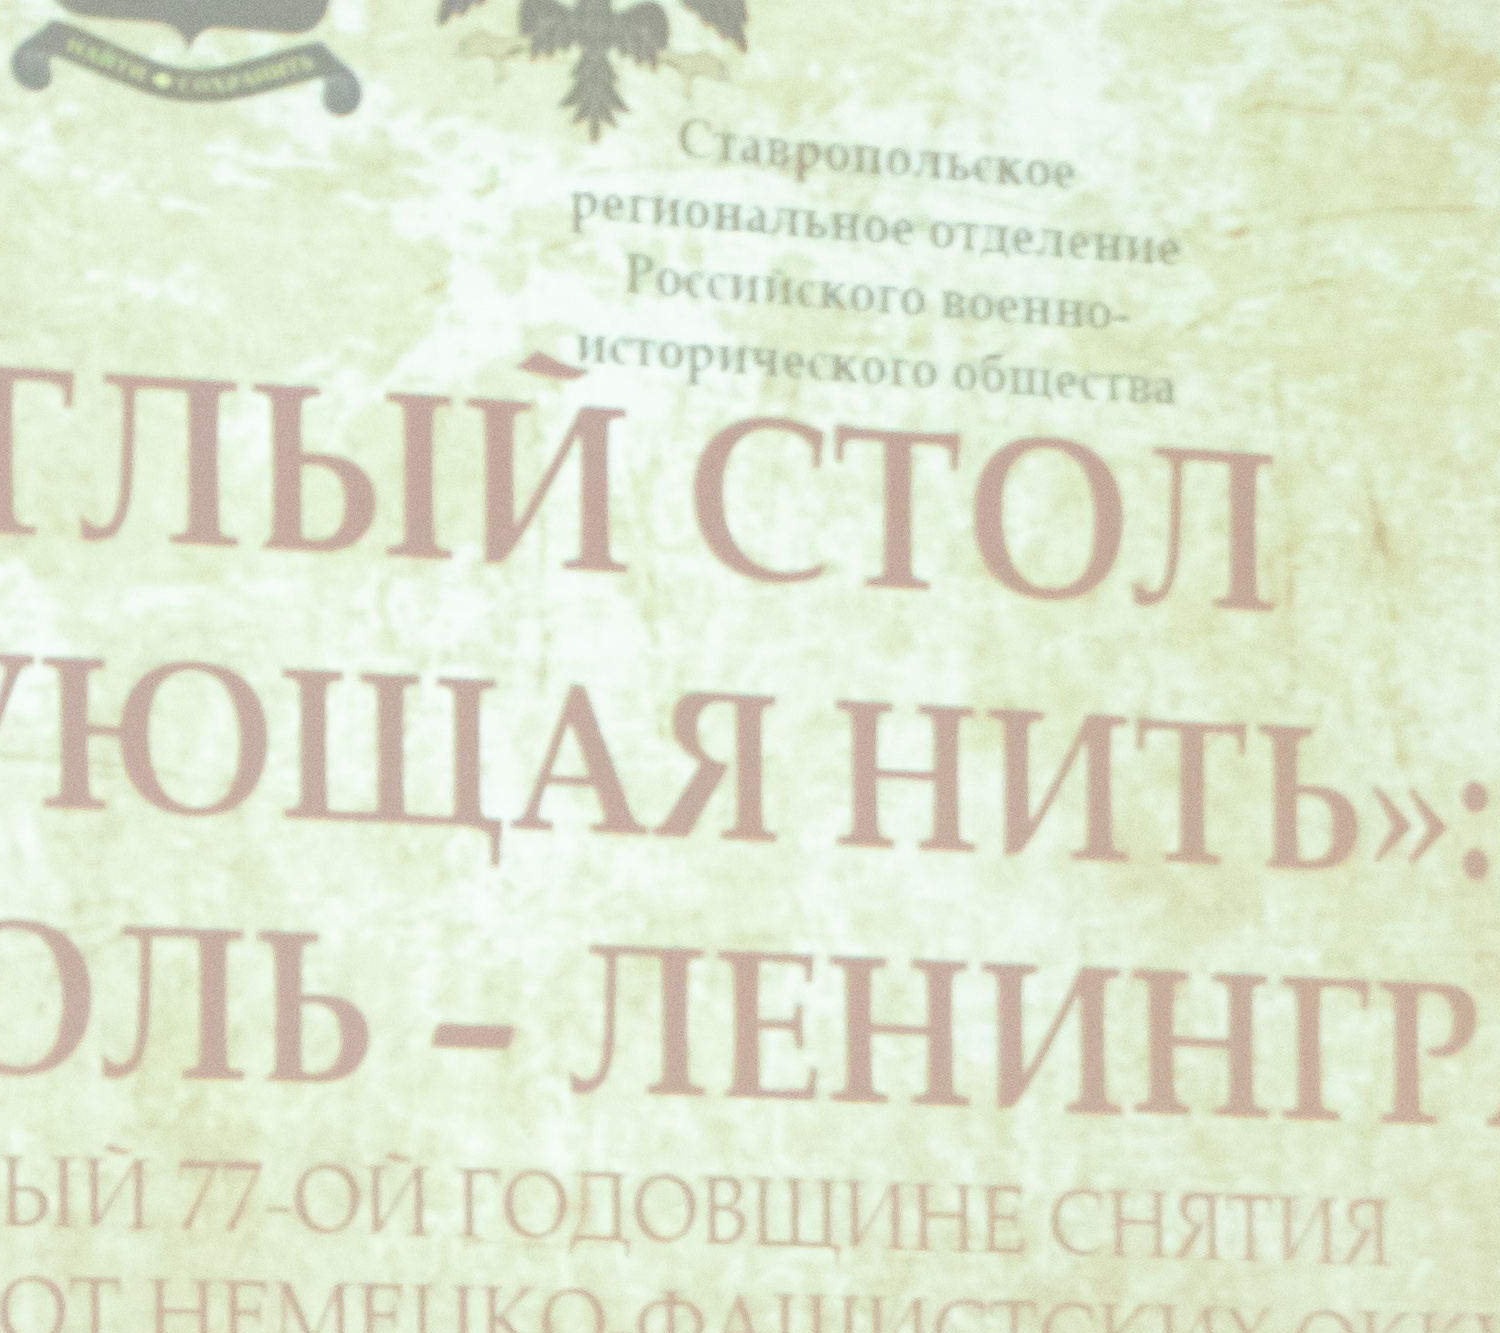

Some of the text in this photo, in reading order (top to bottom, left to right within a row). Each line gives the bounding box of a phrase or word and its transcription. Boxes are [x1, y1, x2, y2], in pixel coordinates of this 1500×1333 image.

[677, 117, 1077, 191] Ставропольское
[569, 188, 1183, 267] региональное отделение
[625, 251, 1132, 331] Российского военно-
[576, 331, 1178, 406] исторического общества
[691, 415, 1277, 611] СТОЛ
[834, 696, 1490, 882] НИТЬ»:
[177, 1149, 430, 1239] 77-ОЙ
[455, 1165, 1028, 1258] ГОДОВЩИНЕ
[1046, 1188, 1391, 1267] СНЯТИЯ
